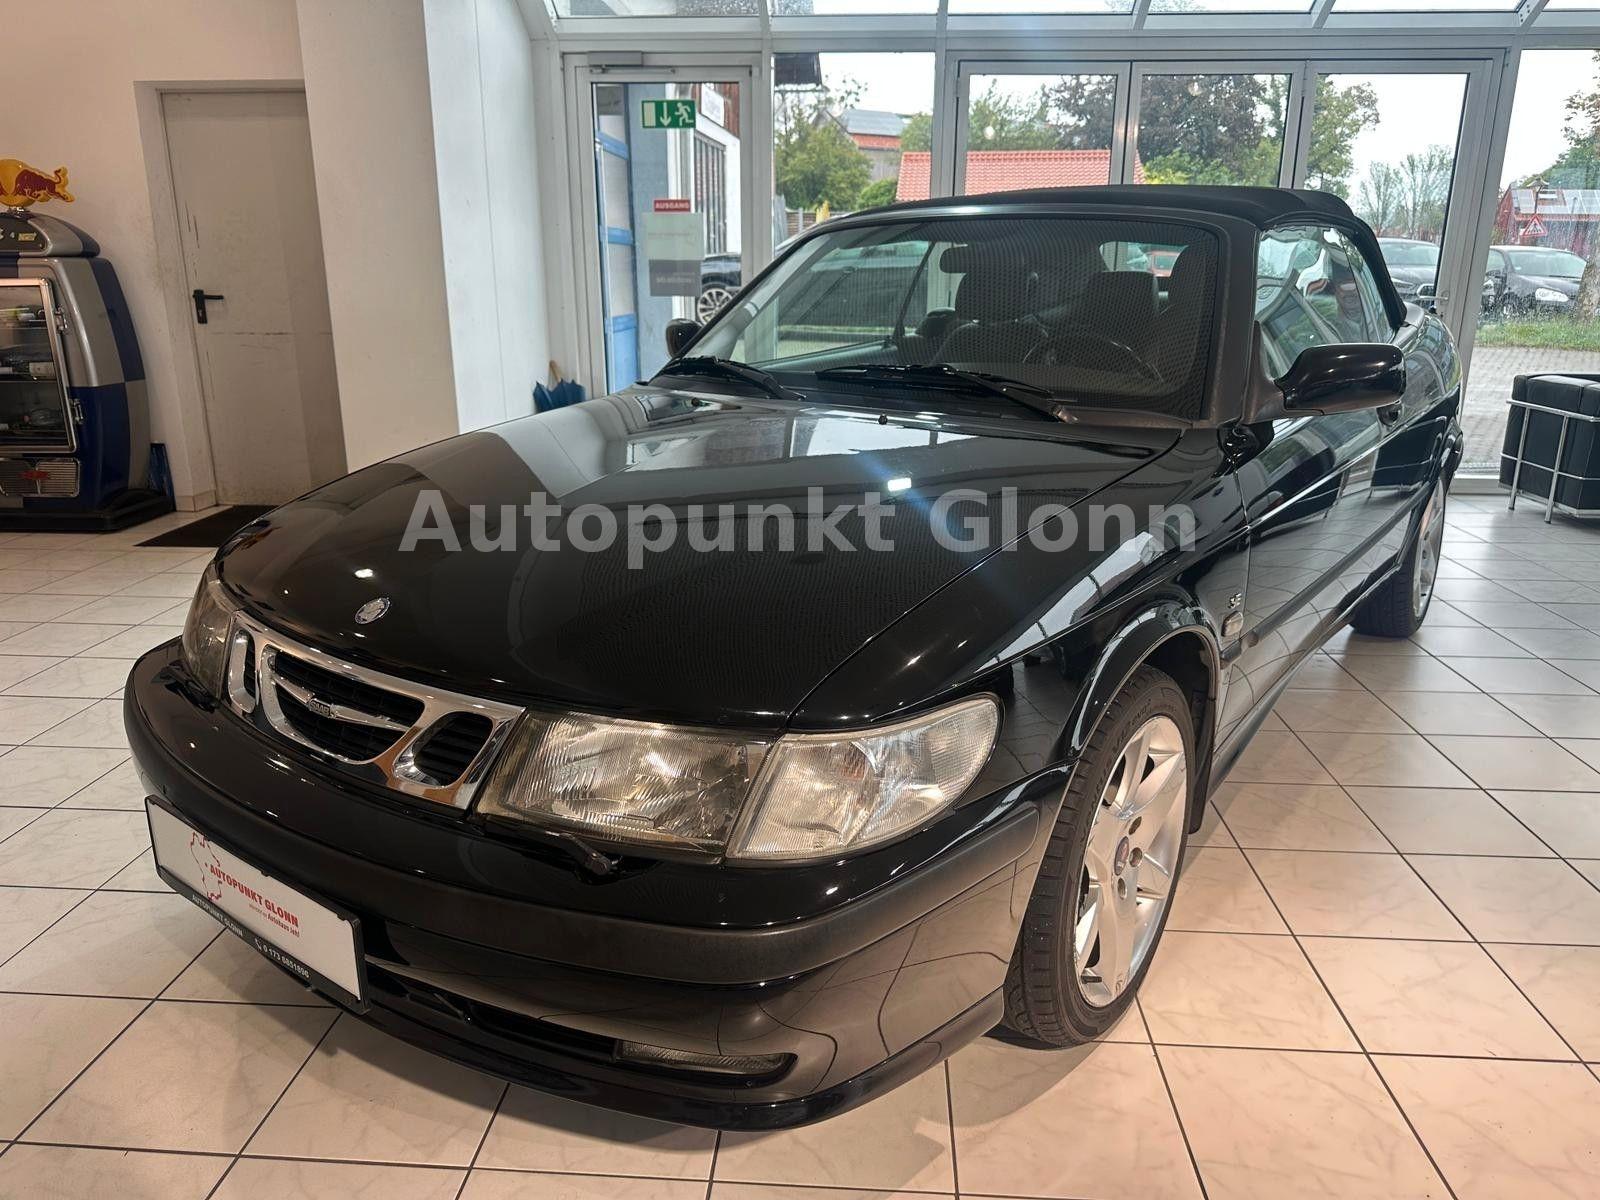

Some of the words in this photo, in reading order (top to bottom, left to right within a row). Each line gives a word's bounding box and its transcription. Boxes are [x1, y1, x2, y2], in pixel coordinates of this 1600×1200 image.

[655, 201, 690, 209] AUSGANG
[310, 700, 330, 715] SAAB
[210, 863, 263, 906] AUTOPUNKT
[264, 898, 299, 928] GLONN
